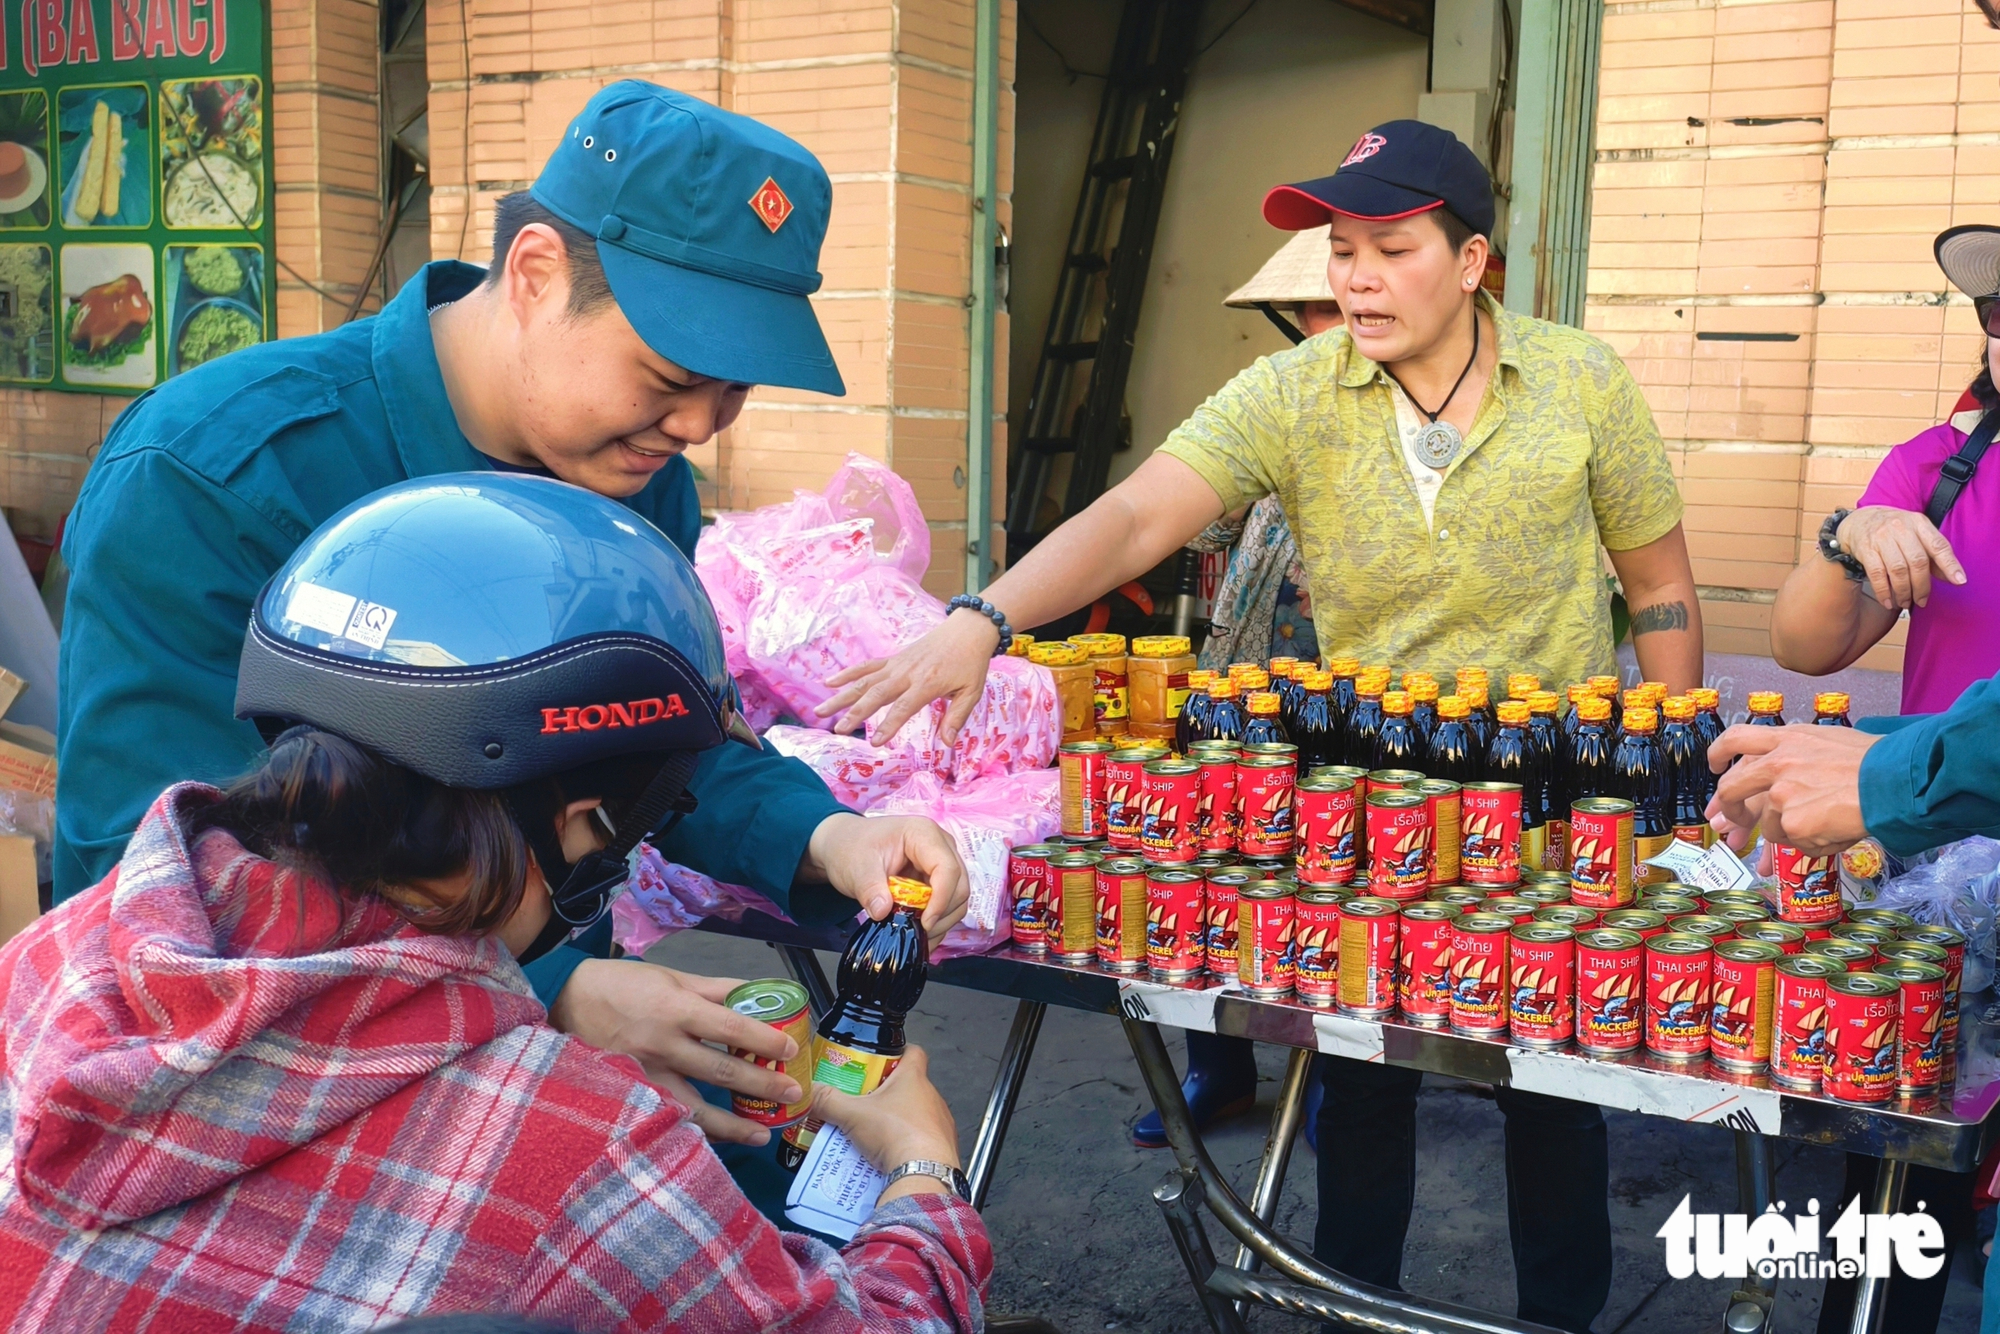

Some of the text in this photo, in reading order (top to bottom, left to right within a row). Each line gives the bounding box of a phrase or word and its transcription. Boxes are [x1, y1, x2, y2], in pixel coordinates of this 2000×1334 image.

[540, 693, 690, 735] HONDA
[1152, 782, 1175, 792] SHIP
[1477, 799, 1500, 808] SHIP
[1152, 888, 1174, 899] SHIP
[1315, 911, 1339, 922] SHIP
[1529, 950, 1554, 962] SHIP
[1589, 956, 1640, 969] THAI SHIP
[1655, 960, 1708, 973] THAI SHIP
[1796, 986, 1825, 999] THAI
[1920, 990, 1943, 1002] THAI
[1589, 1019, 1639, 1032] MACKEREL
[1655, 1024, 1708, 1037] MACKEREL
[1600, 1031, 1621, 1039] Tomato
[836, 1177, 857, 1207] PHIÊN
